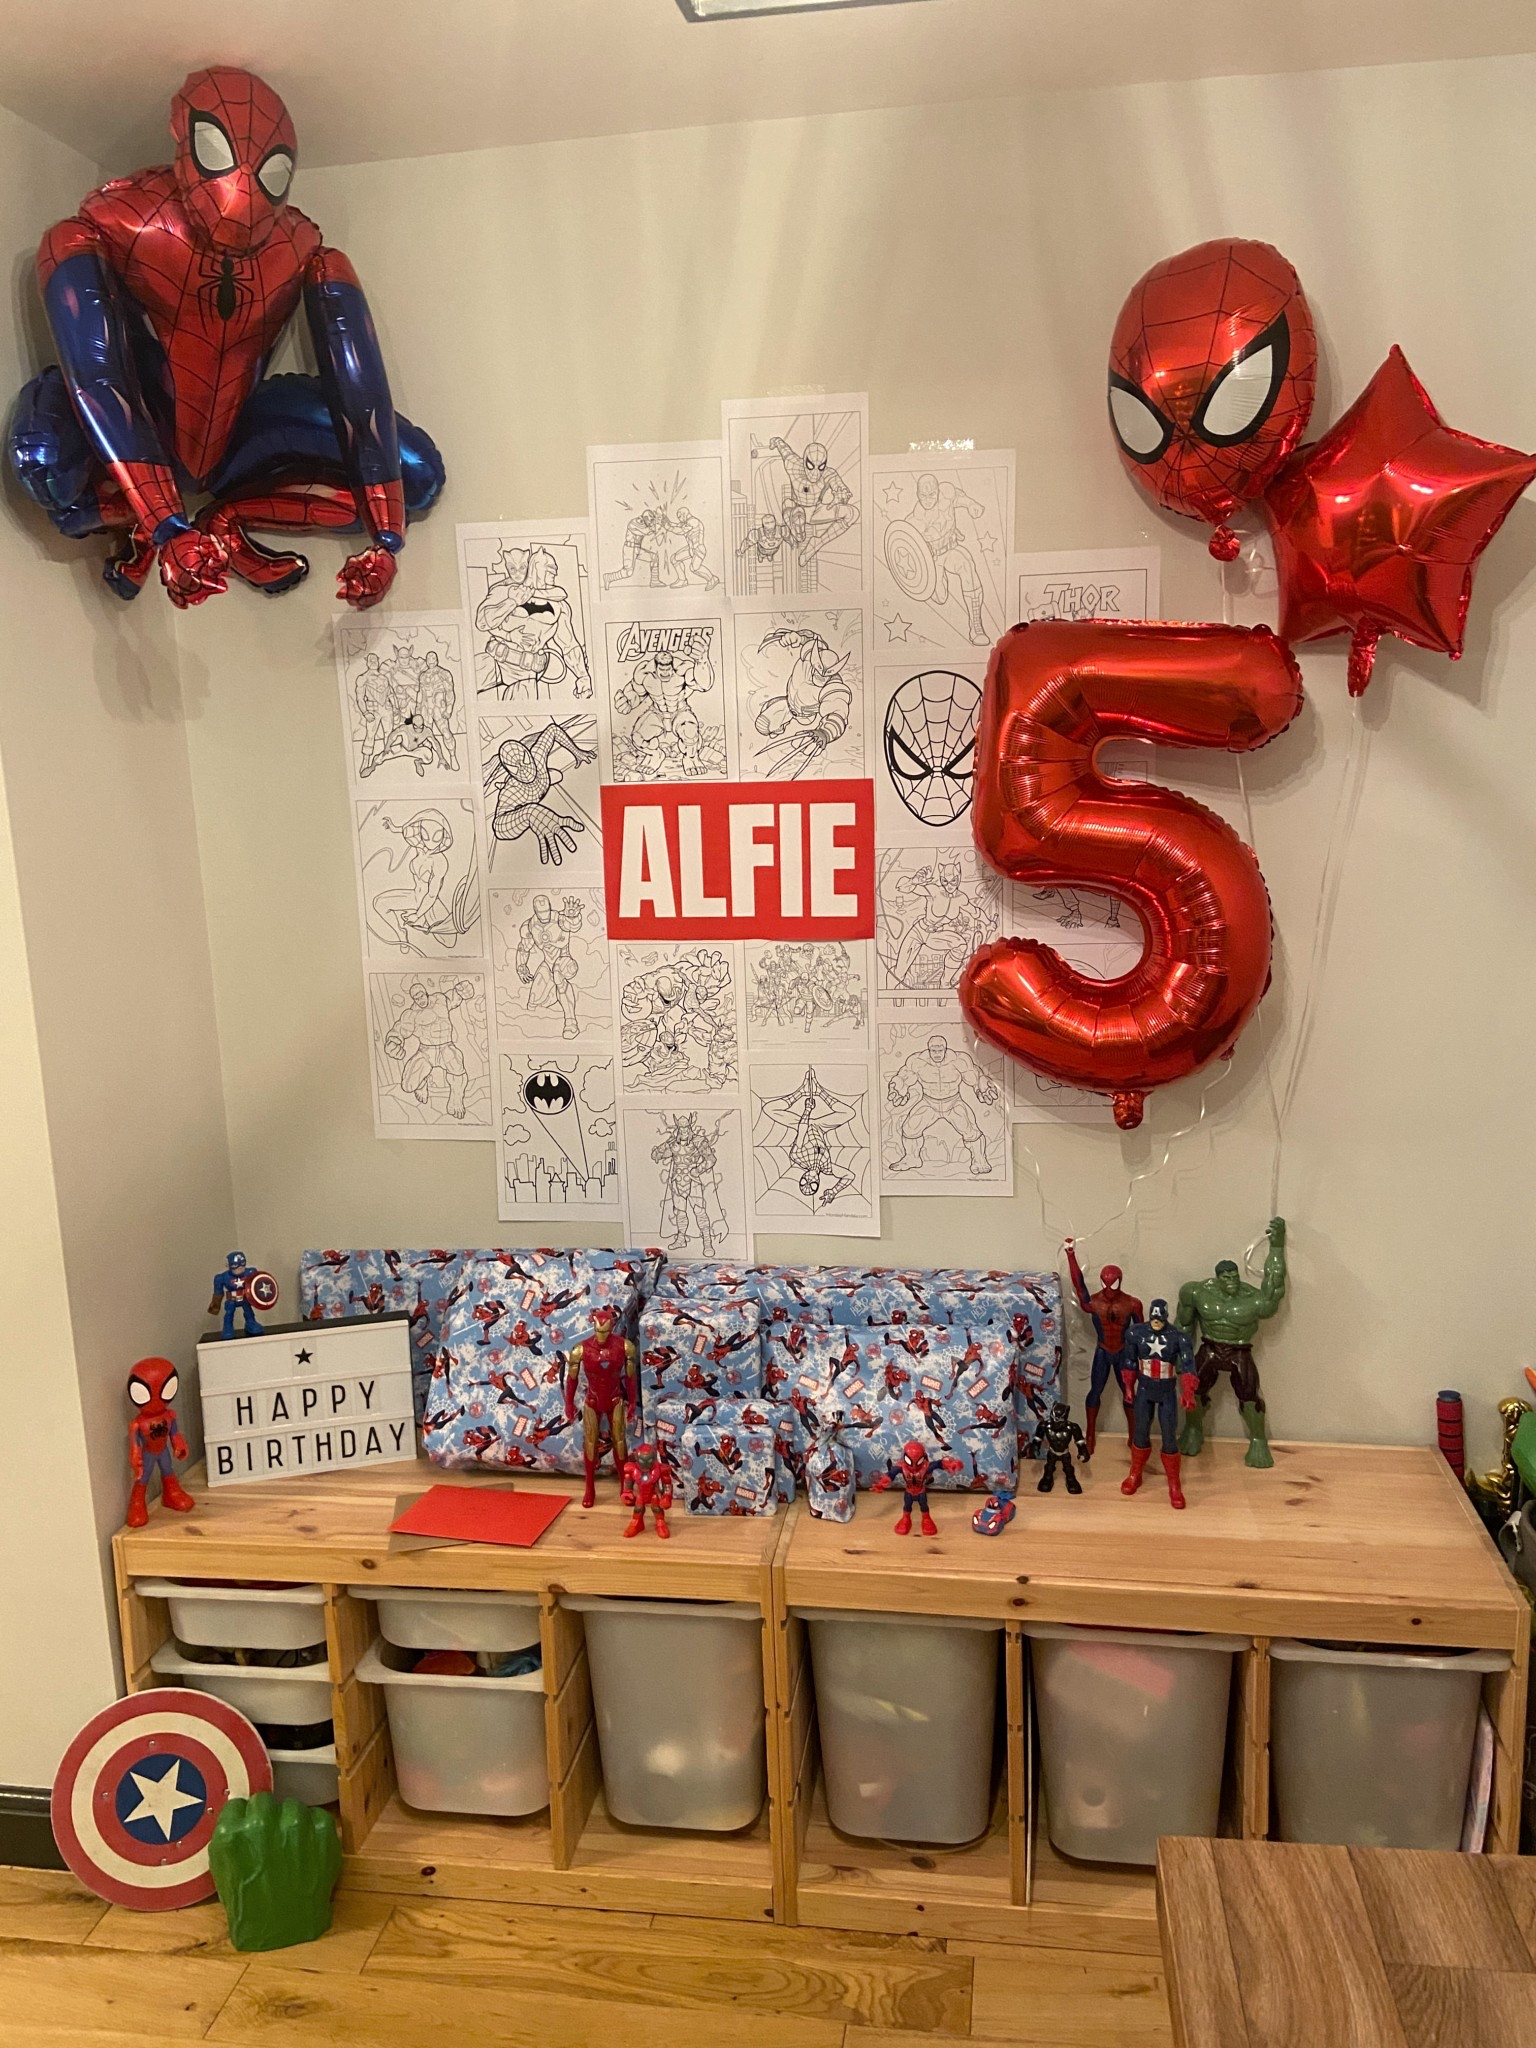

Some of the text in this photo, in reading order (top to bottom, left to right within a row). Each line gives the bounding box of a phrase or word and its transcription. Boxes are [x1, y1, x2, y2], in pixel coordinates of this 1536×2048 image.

[1043, 583, 1121, 614] THOR
[619, 802, 858, 918] ALFIE
[959, 617, 1303, 1096] 5
[1151, 1306, 1162, 1317] A
[693, 1336, 706, 1353] MARVEL
[1025, 1363, 1044, 1377] MARVEL
[799, 1375, 819, 1390] MARVEL
[844, 1379, 864, 1398] MARVEL
[922, 1376, 941, 1391] MARVEL
[968, 1379, 988, 1397] MARVEL
[236, 1380, 375, 1427] HAPPY
[513, 1415, 527, 1436] MARVEL
[657, 1420, 675, 1433] MARVEL
[217, 1422, 405, 1475] BIRTHDAY
[736, 1487, 755, 1499] MARVEL
